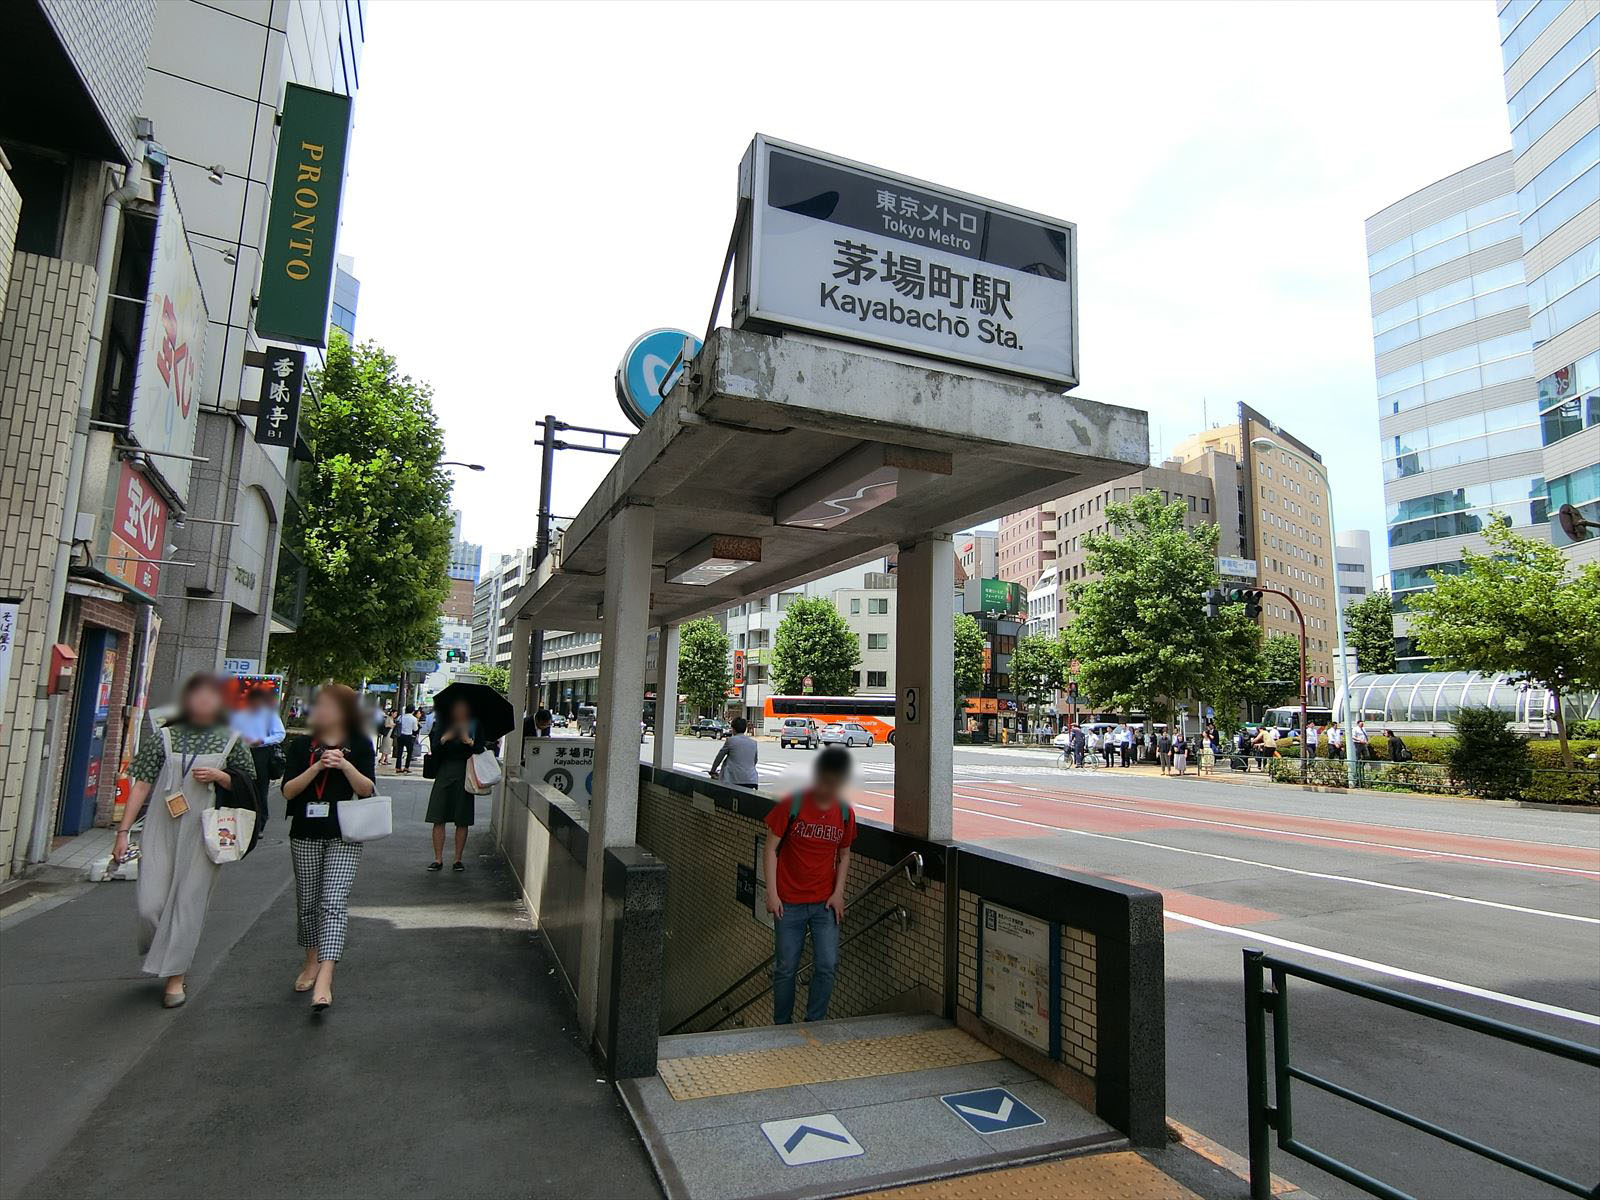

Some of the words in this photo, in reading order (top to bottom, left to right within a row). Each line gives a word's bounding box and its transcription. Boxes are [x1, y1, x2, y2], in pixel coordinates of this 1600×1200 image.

[286, 140, 325, 282] PRONTO
[875, 189, 977, 234] 東京メトロ
[882, 214, 926, 240] Tokyo
[929, 227, 971, 251] Metro
[832, 239, 1014, 321] 茅場町駅
[820, 282, 970, 339] Kayabachō
[977, 319, 1024, 351] Sta.
[266, 357, 295, 428] 香味亭
[124, 477, 160, 551] 宝くじ
[906, 688, 916, 722] 3
[532, 746, 540, 755] 3
[553, 758, 593, 766] Kayabachō
[555, 747, 594, 759] 茅場町
[791, 821, 844, 843] ANGELS
